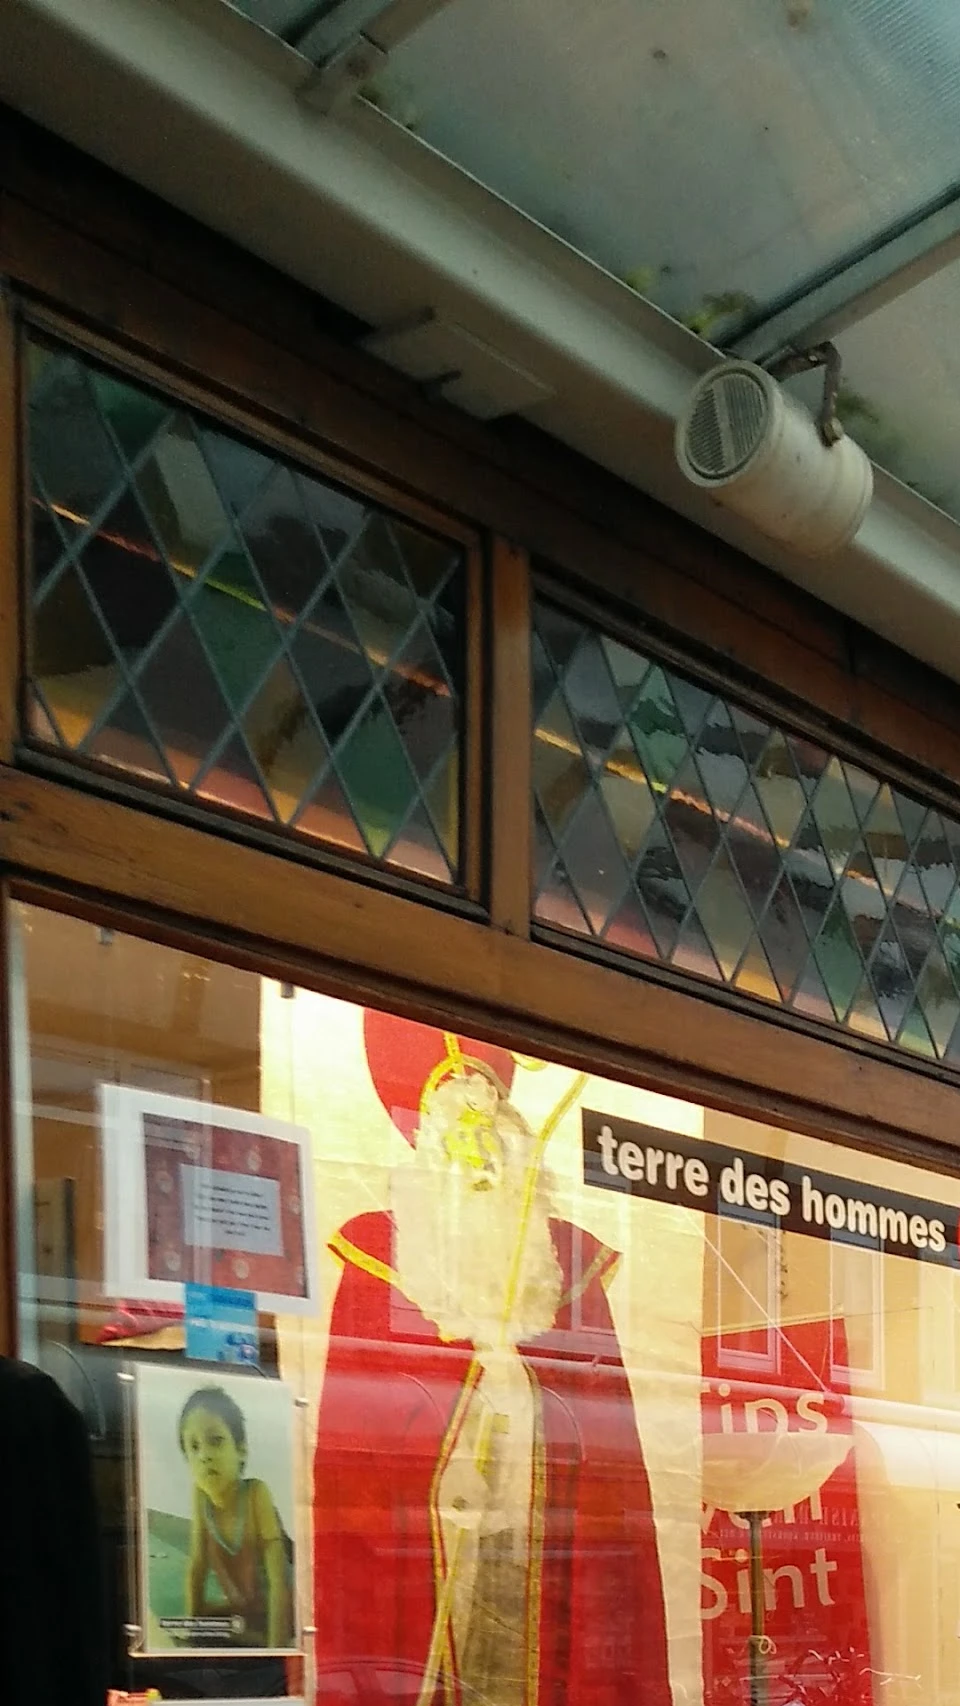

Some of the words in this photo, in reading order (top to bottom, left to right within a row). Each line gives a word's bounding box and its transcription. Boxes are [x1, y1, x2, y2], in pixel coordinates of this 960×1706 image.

[597, 1125, 710, 1197] terre
[720, 1158, 791, 1216] des
[802, 1175, 946, 1252] hommes
